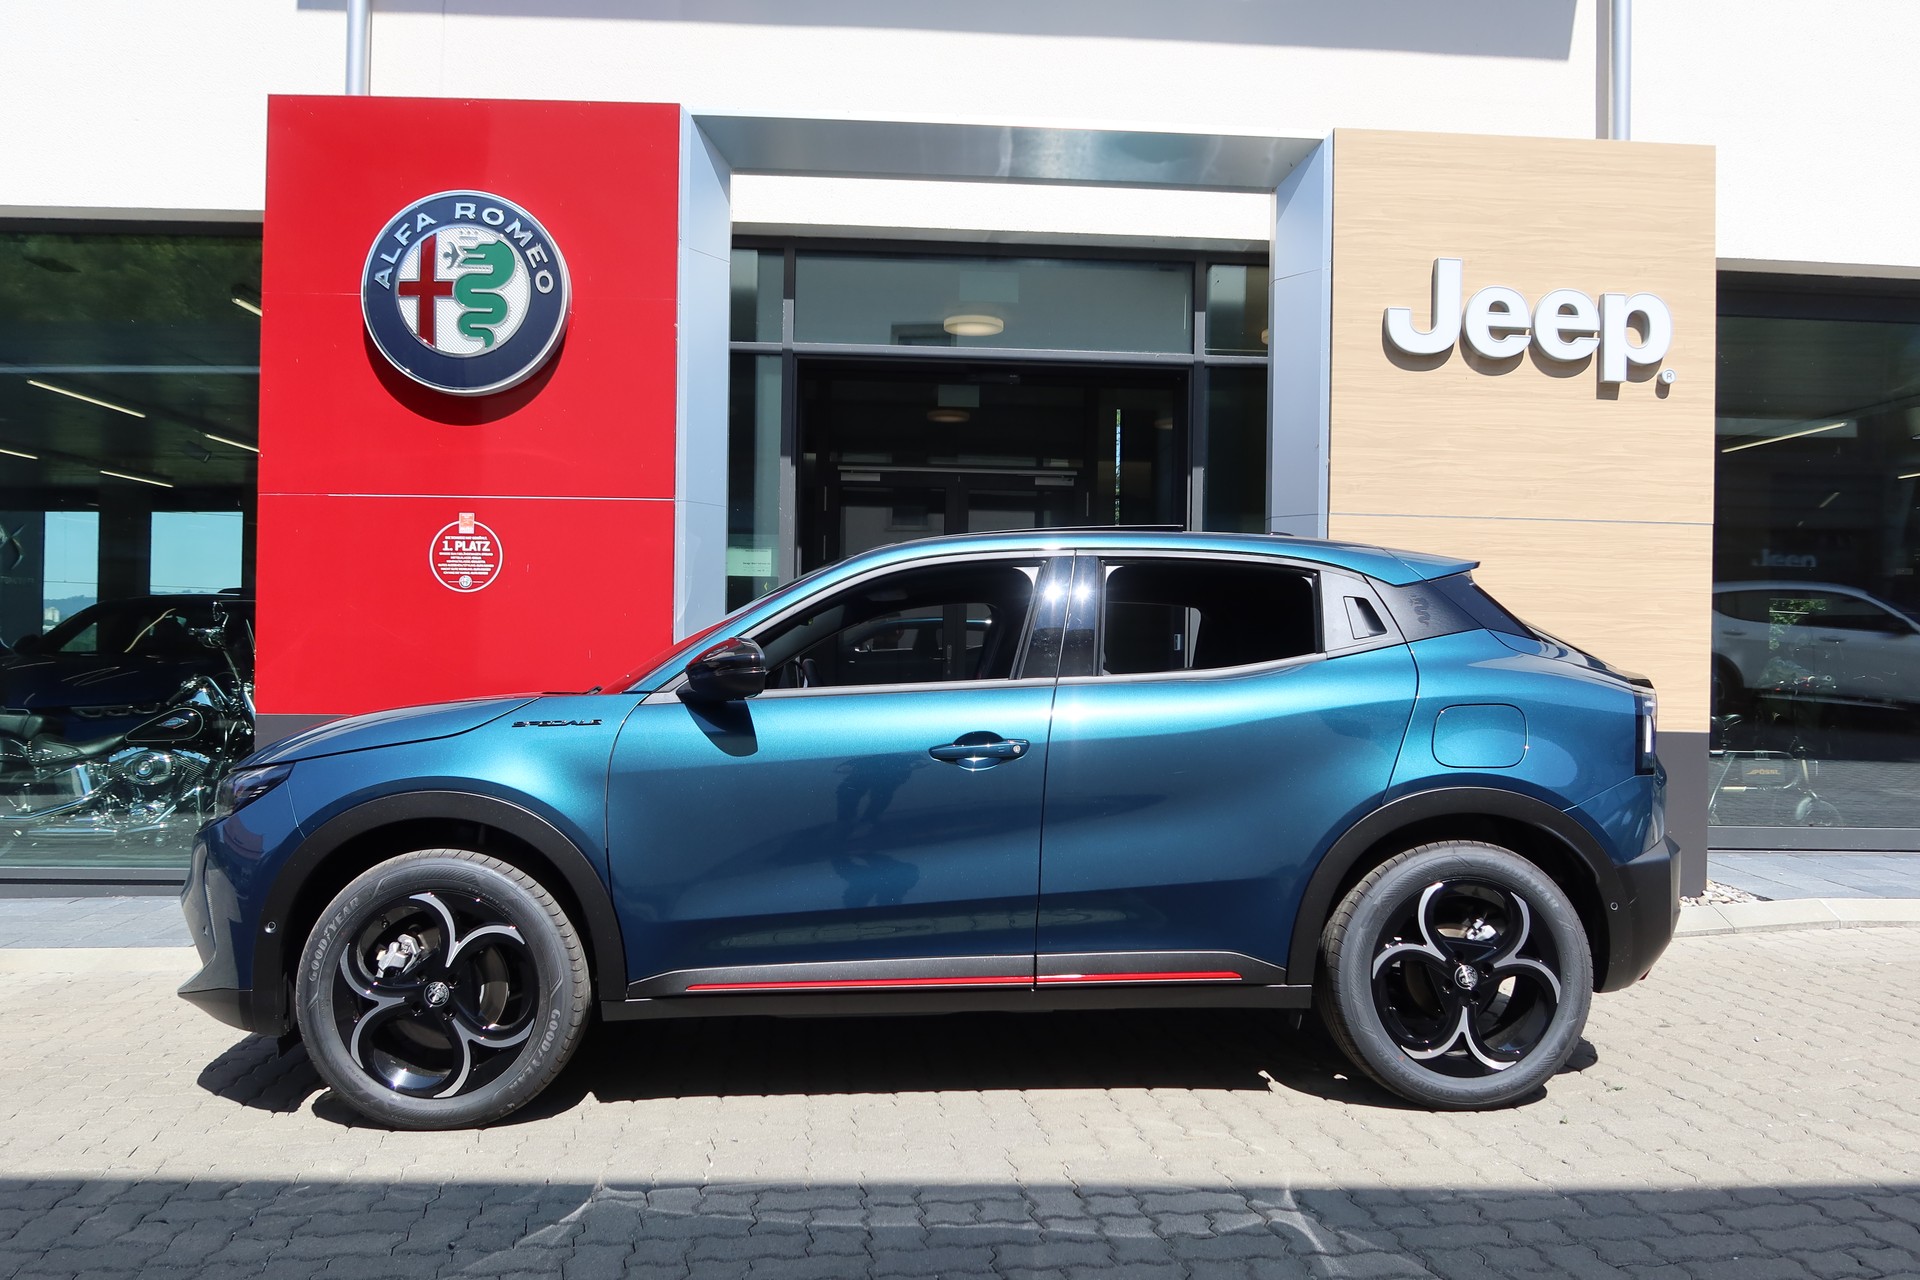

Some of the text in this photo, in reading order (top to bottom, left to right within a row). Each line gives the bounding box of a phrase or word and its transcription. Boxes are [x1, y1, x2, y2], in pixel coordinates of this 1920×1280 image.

[374, 203, 554, 294] ALFA ROMEO
[1384, 257, 1673, 383] Jeep
[442, 540, 491, 552] 1. PLATZ
[308, 896, 359, 982] GOODYEAR
